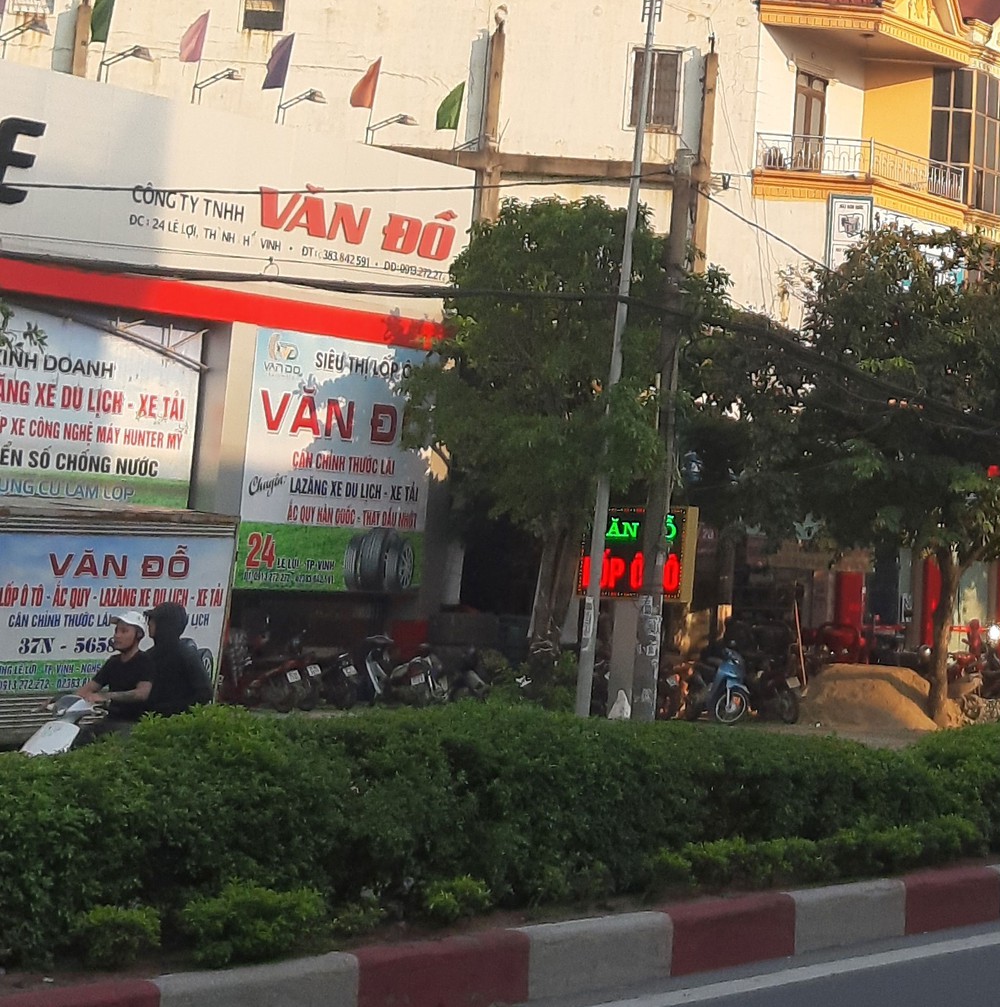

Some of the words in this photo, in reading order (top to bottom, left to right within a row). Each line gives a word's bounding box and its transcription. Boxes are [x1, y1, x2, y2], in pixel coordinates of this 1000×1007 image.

[132, 182, 176, 209] CÔNG
[180, 194, 199, 214] TY
[203, 198, 245, 223] TNHH
[152, 218, 165, 231] 24
[168, 219, 179, 233] LÊ
[260, 238, 281, 251] VINH
[0, 349, 37, 370] INH
[43, 354, 114, 378] DOANH
[315, 349, 344, 372] SIÊU
[349, 356, 369, 381] THỊ
[35, 382, 57, 408] XE
[61, 385, 83, 410] DU
[87, 388, 123, 419] LỊCH
[138, 393, 158, 418] XE
[163, 390, 185, 420] TẢI
[260, 385, 355, 442] VĂN
[10, 418, 26, 436] XE
[29, 417, 60, 440] CÔNG
[64, 421, 93, 446] NGHỆ
[96, 423, 120, 443] MÁY
[124, 428, 164, 447] HUNTER
[28, 445, 52, 469] SỐ
[55, 448, 111, 474] CHỐNG
[116, 455, 159, 477] NƯỚC
[290, 475, 328, 496] LAZĂNG
[330, 480, 343, 497] XE
[345, 481, 358, 498] DU
[360, 482, 382, 503] LỊCH
[390, 484, 401, 502] XE
[606, 517, 639, 538] ĂN
[49, 548, 128, 578] VĂN
[141, 544, 190, 579] ĐỖ
[246, 533, 275, 569] 24
[69, 587, 91, 609] QUY
[99, 585, 137, 607] LAZĂNG
[138, 588, 151, 607] XE
[196, 588, 208, 607] XE
[8, 611, 29, 628] CÂN
[31, 610, 61, 628] CHỈNH
[63, 612, 94, 628] THƯỚC
[191, 613, 209, 629] LỊCH
[18, 637, 55, 655] 37N
